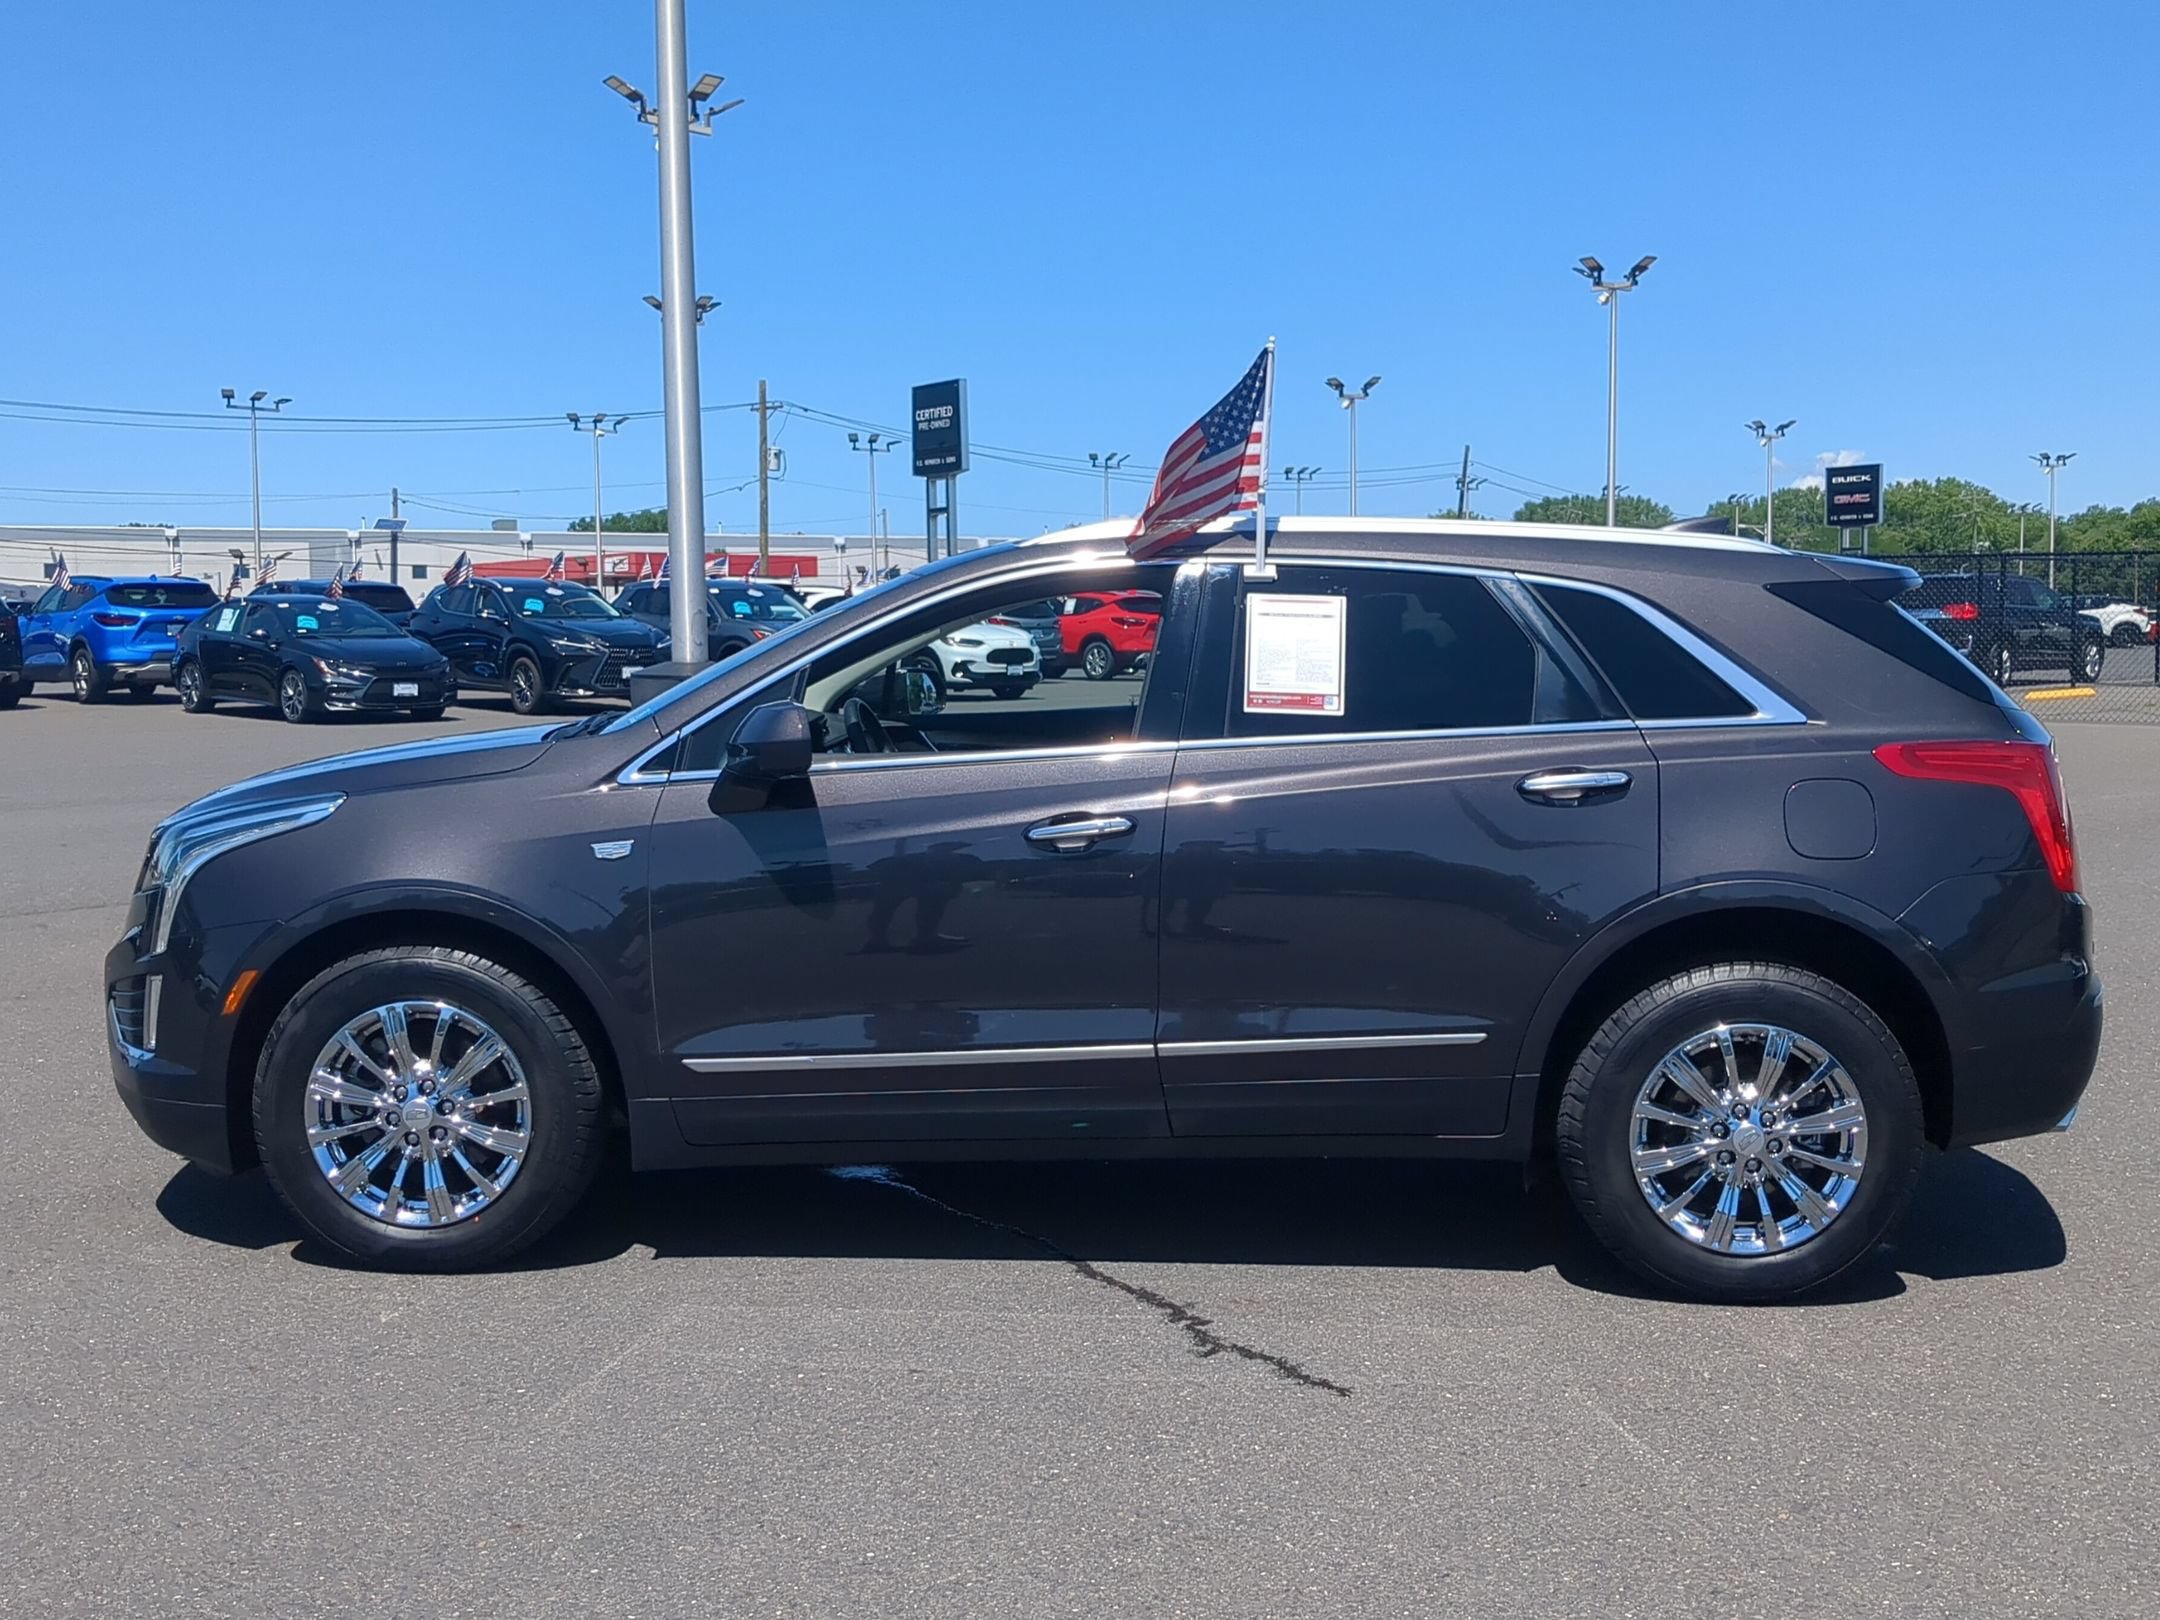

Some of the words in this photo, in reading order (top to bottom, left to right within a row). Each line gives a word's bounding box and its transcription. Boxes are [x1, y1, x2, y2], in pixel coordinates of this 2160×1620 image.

[916, 405, 953, 421] CERTIFIED
[918, 418, 950, 430] PRE-OWNED
[1832, 474, 1872, 484] BUICK
[1834, 493, 1871, 504] GMC
